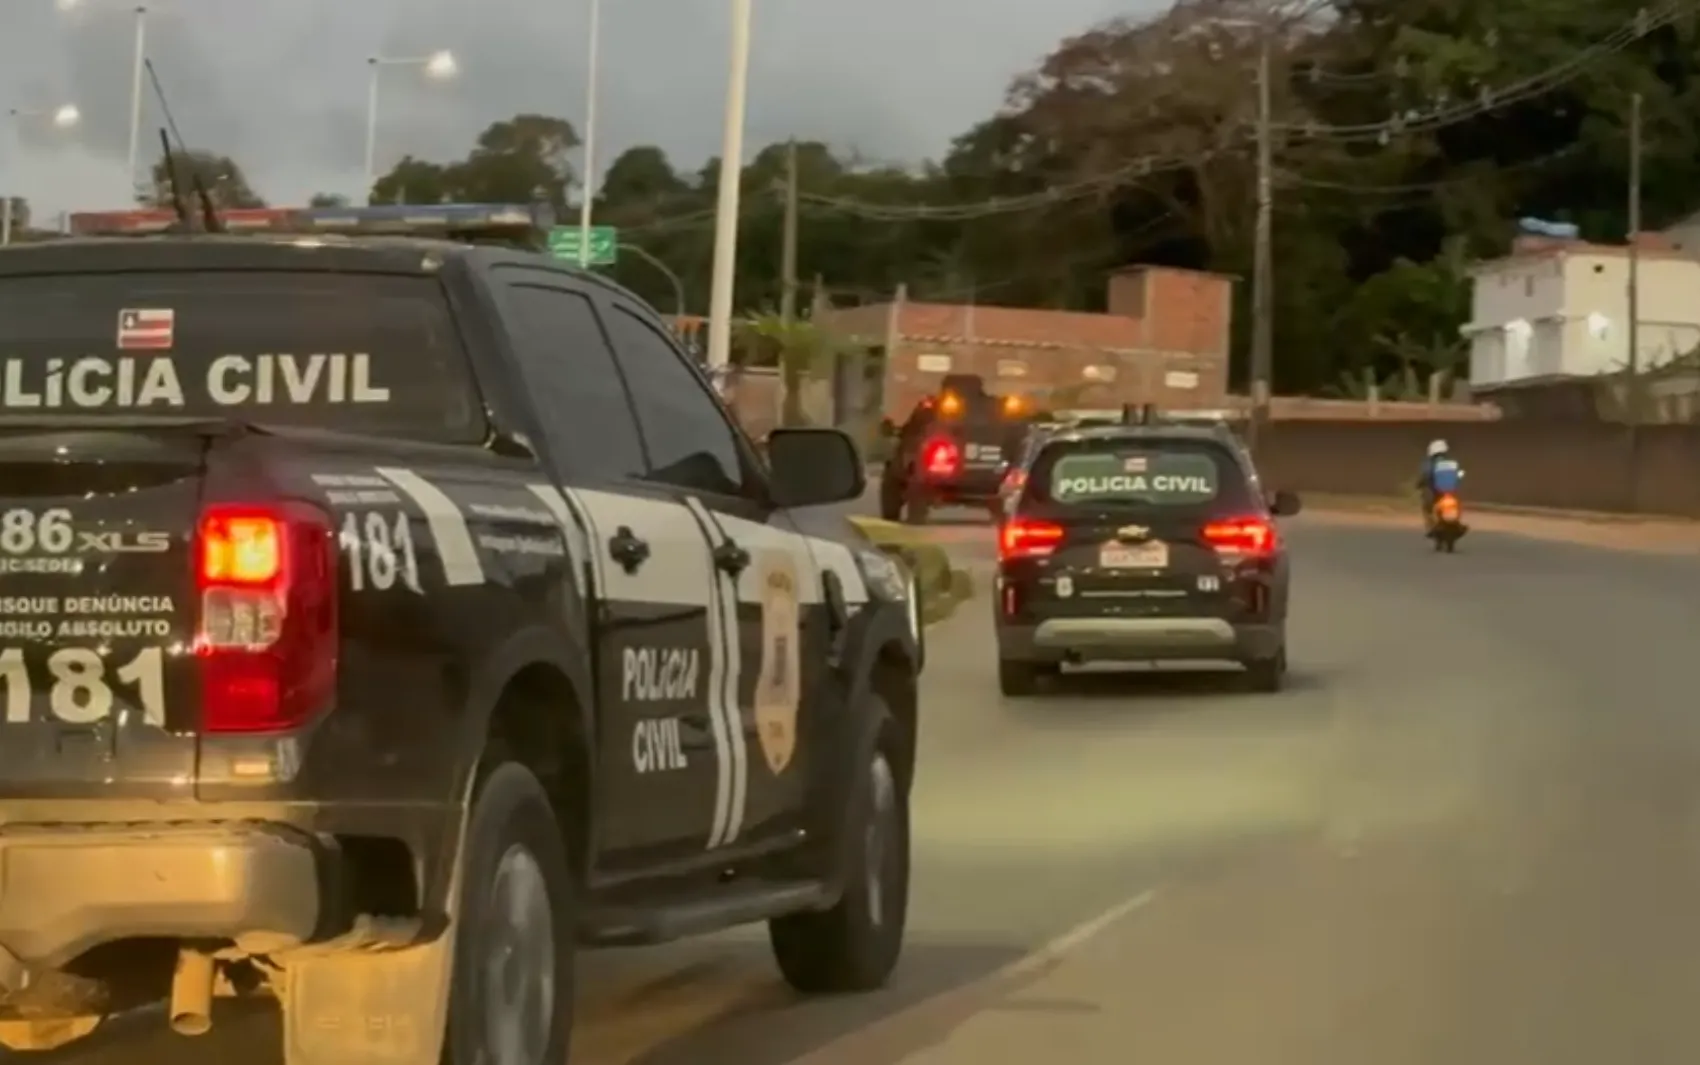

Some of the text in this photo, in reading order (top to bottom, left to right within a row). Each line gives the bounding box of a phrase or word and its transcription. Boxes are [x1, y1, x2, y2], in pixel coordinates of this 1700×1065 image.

[206, 353, 390, 405] CIVIL
[1153, 475, 1212, 493] CIVIL
[76, 531, 170, 552] XLS
[339, 510, 425, 596] 181
[58, 619, 171, 637] ABSOLUTO
[0, 645, 166, 727] 181
[632, 717, 688, 773] CIVIL
